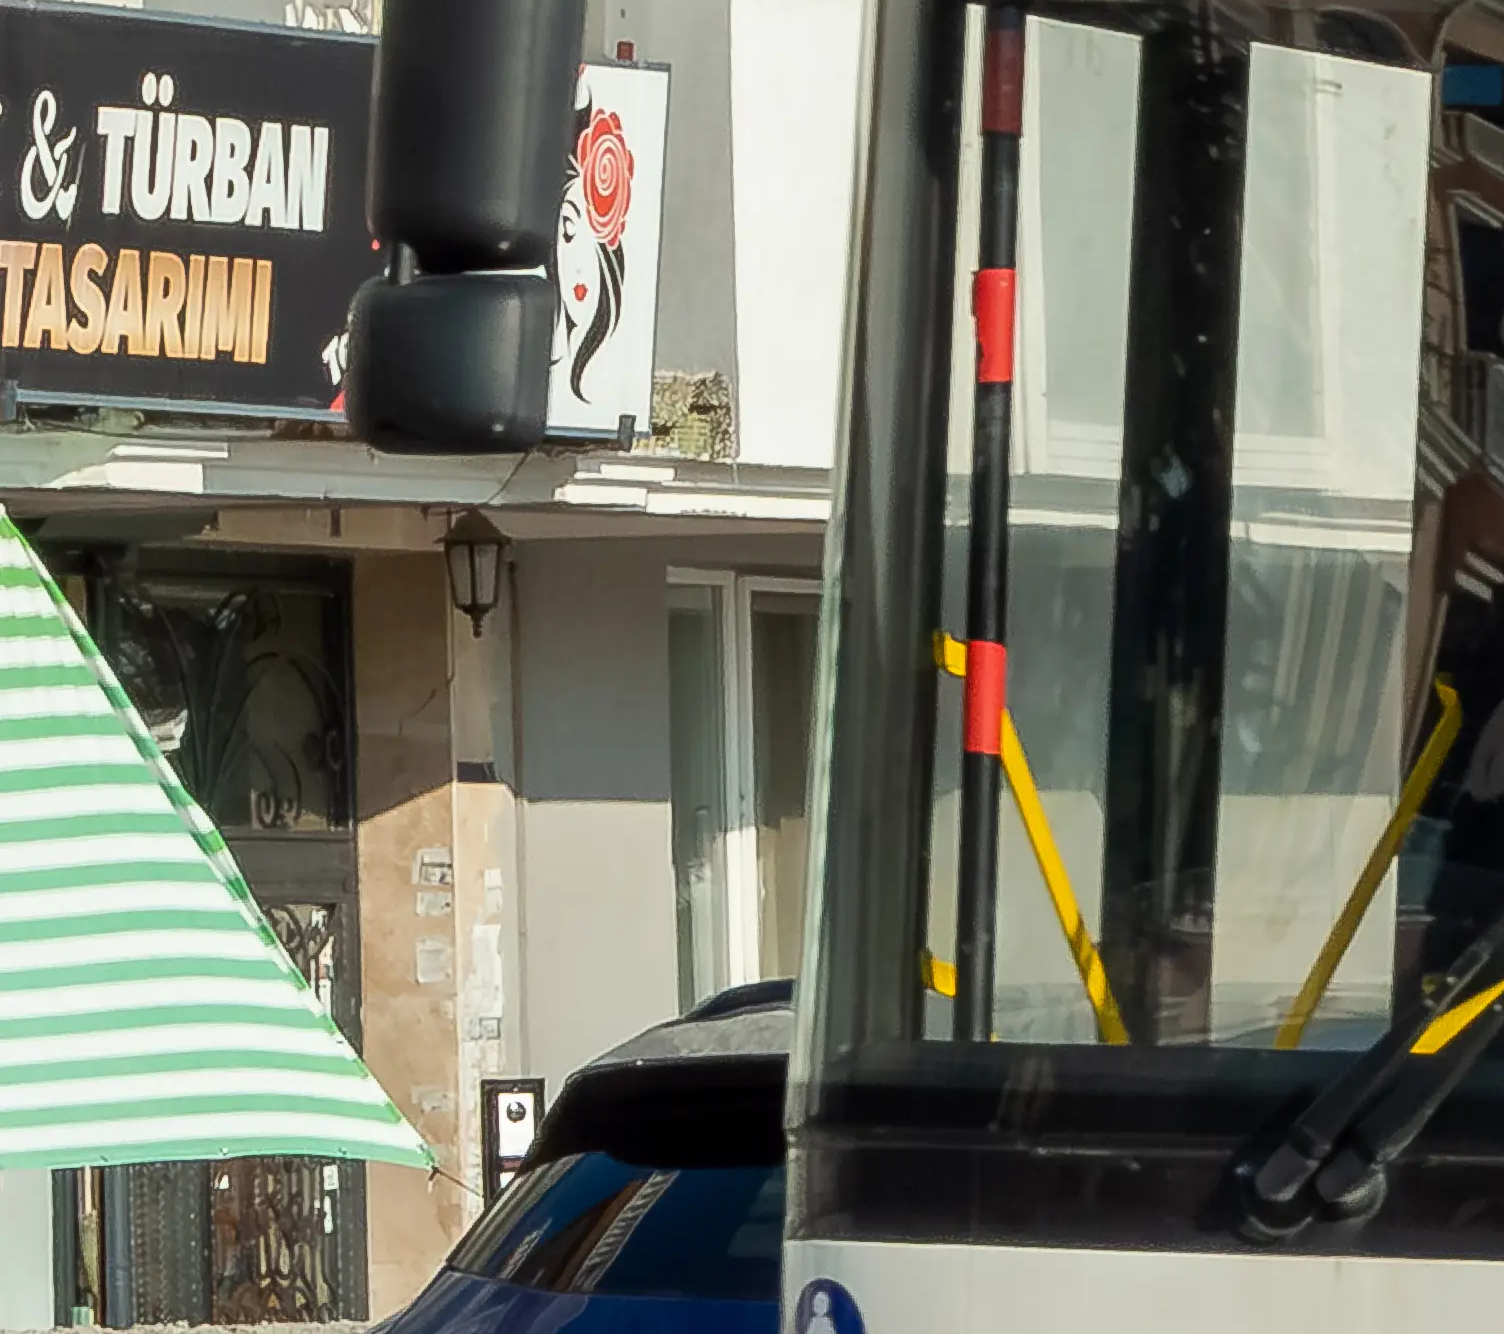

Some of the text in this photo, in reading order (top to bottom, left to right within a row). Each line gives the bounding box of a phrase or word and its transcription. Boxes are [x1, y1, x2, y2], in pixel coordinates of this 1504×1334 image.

[20, 71, 330, 232] & TÜRBAN
[0, 239, 273, 365] TASARIMI
